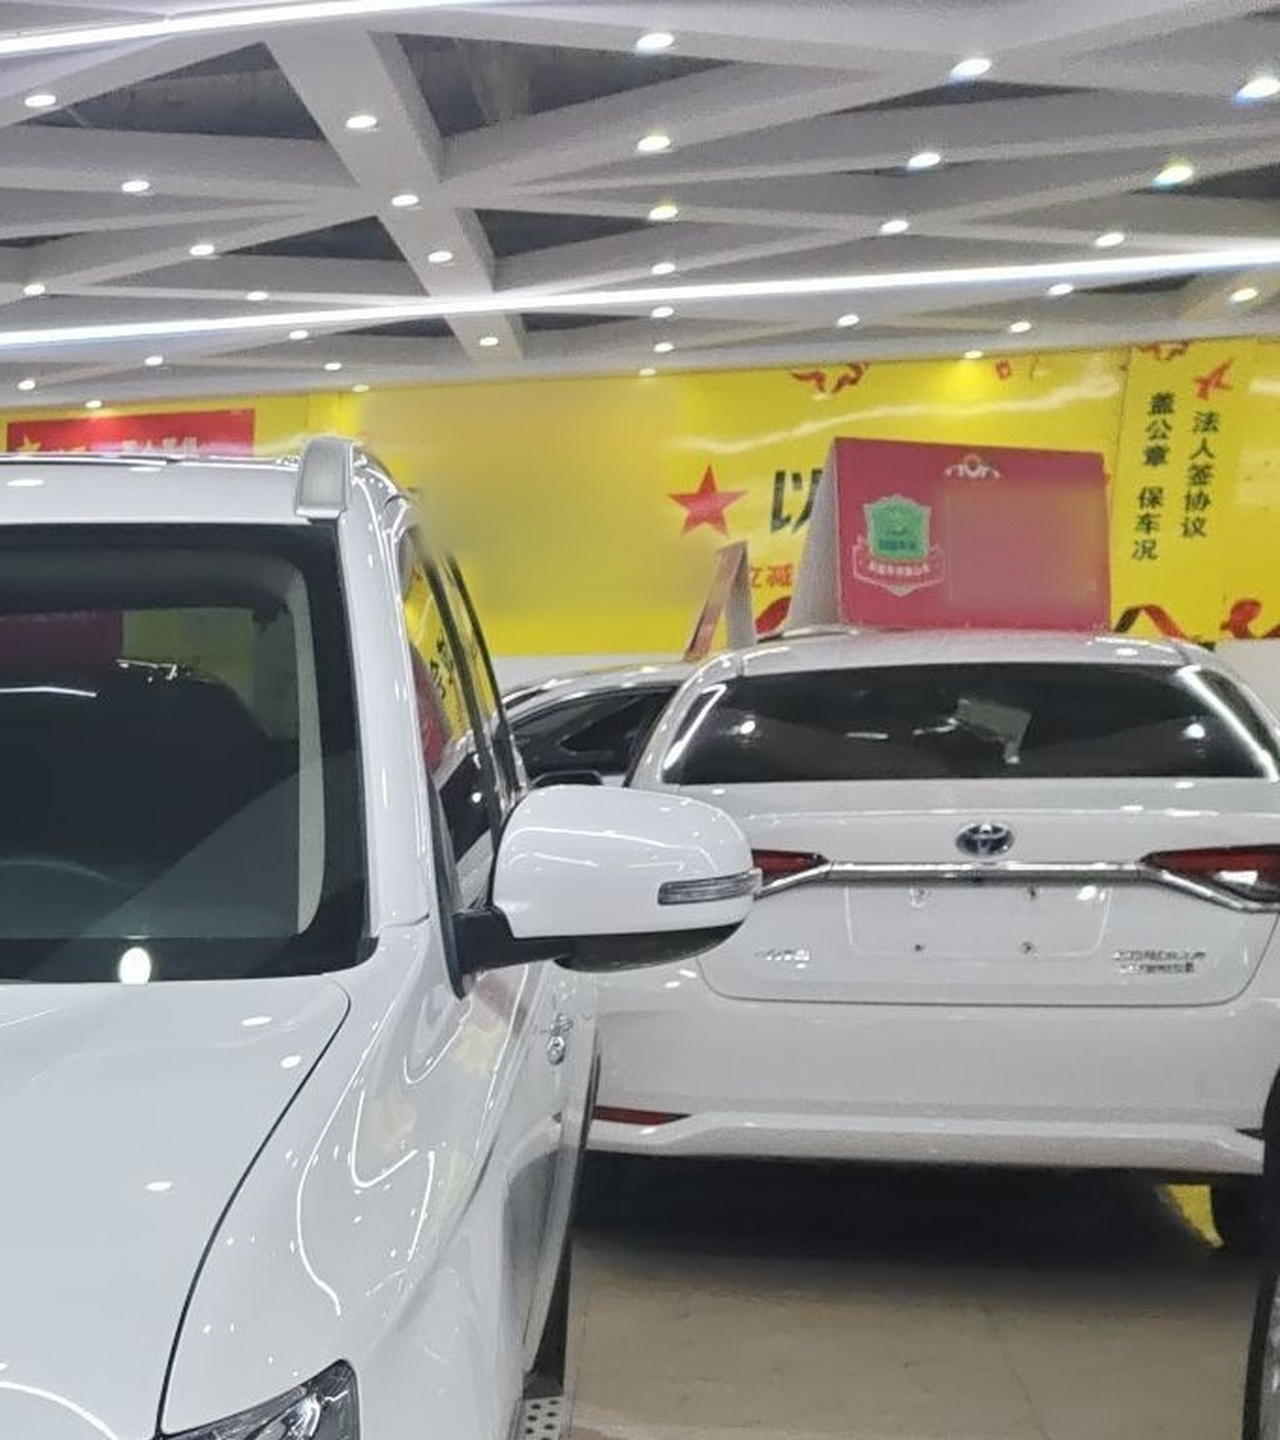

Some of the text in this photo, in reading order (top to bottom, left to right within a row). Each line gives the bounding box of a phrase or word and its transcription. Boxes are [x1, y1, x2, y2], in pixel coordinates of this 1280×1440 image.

[1131, 391, 1175, 561] 盖公章 保车况
[1181, 410, 1220, 538] 法人签协议
